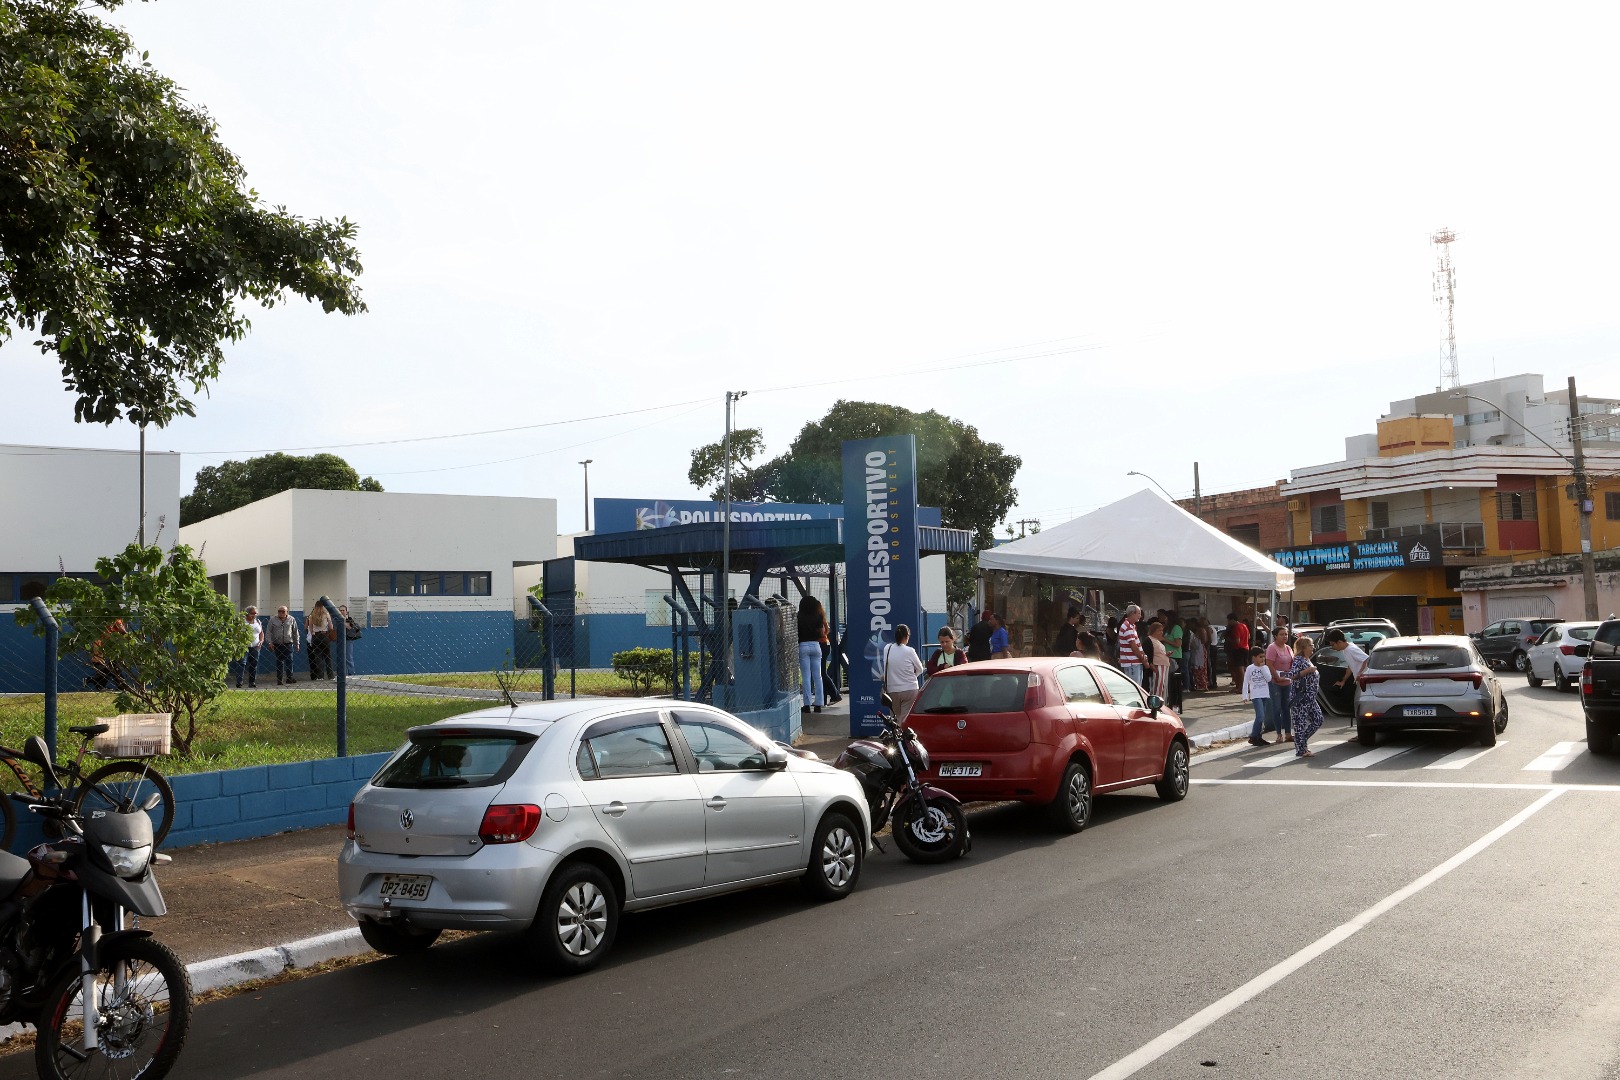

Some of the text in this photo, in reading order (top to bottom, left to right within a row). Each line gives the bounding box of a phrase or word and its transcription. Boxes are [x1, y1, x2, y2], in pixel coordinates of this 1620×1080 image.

[888, 449, 900, 561] ROOSEVELT
[865, 451, 891, 631] POLIESPORTIVO
[1357, 542, 1392, 556] TABACARIA
[1275, 546, 1350, 567] TIO PATINHAS
[1353, 555, 1405, 570] DISTRIBUIDORA
[380, 882, 427, 896] OPZ-8456
